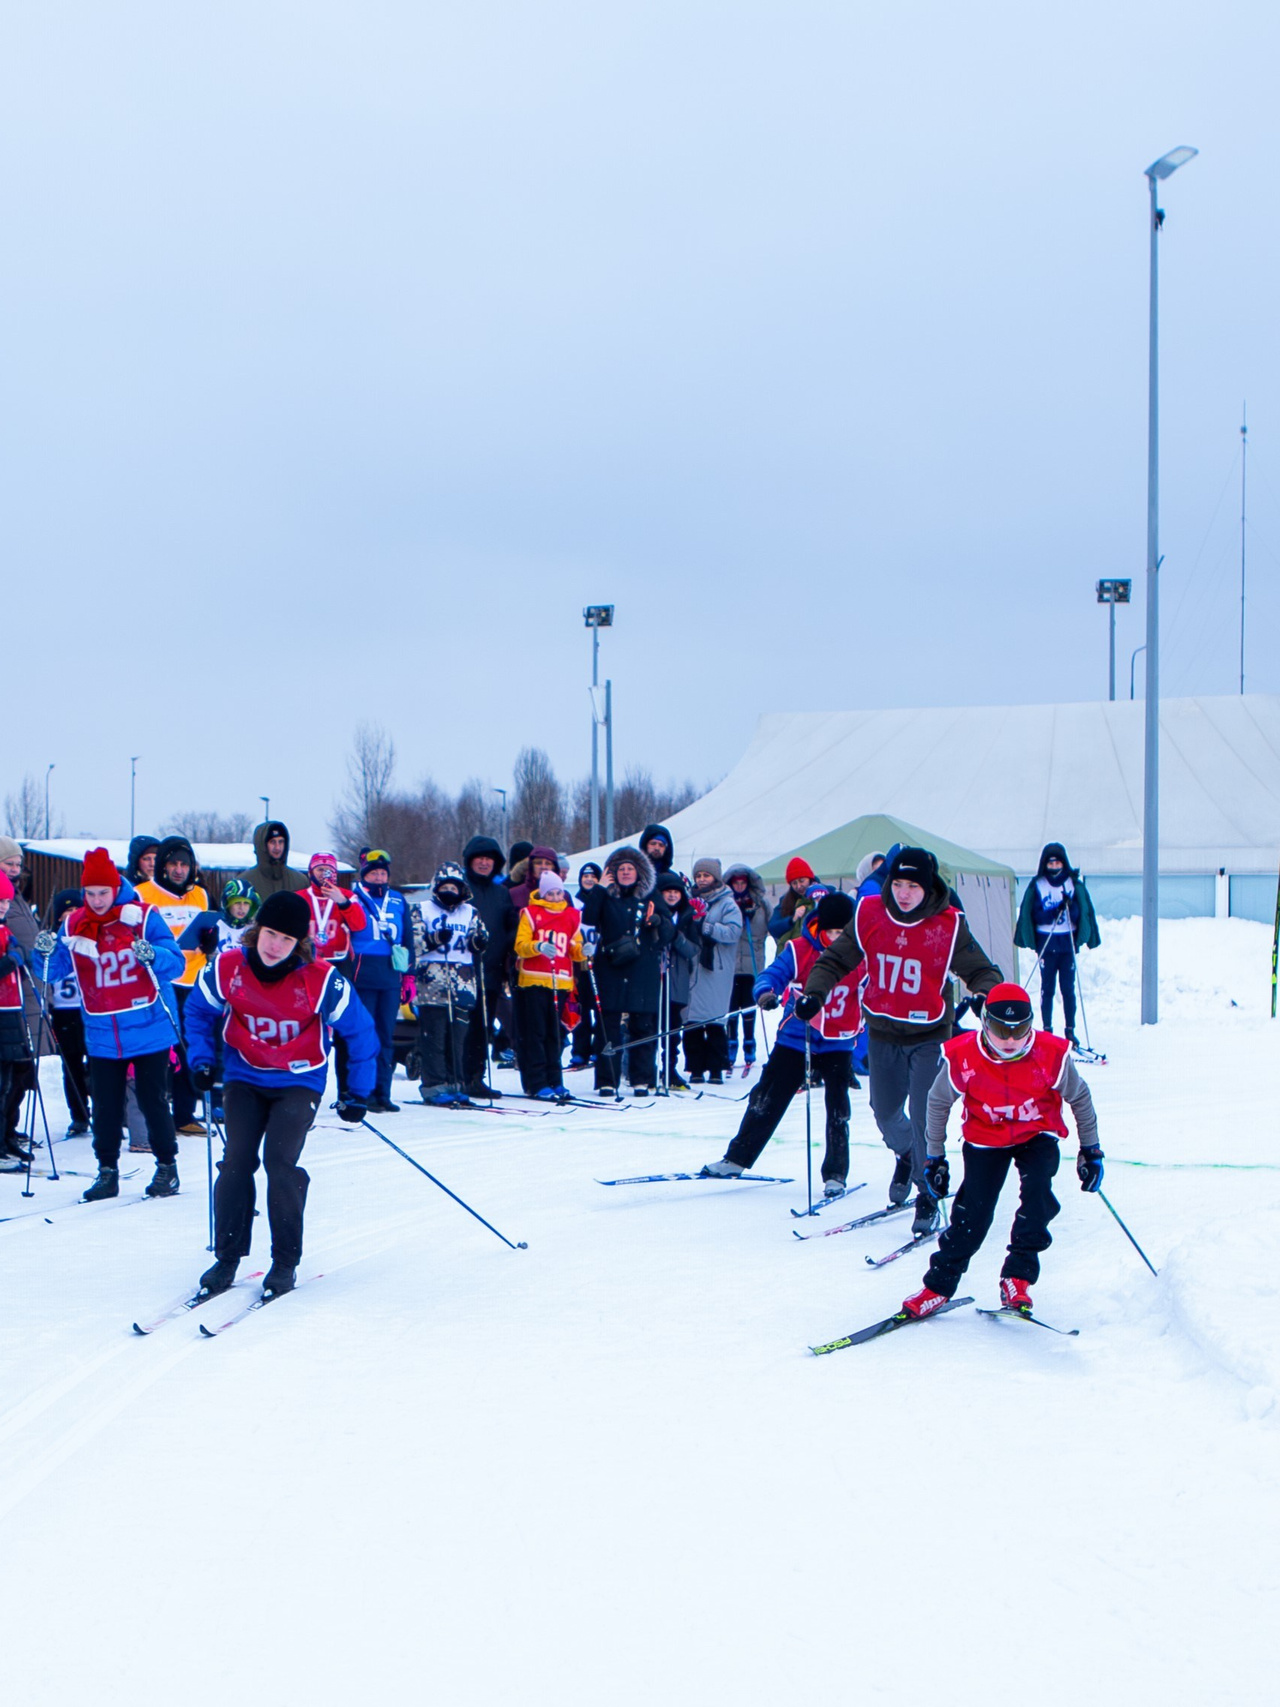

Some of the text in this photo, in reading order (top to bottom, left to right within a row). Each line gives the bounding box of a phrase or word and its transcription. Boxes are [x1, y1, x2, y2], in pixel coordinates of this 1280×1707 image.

[89, 948, 139, 989] 122
[876, 952, 922, 995] 179
[243, 1013, 301, 1049] 120
